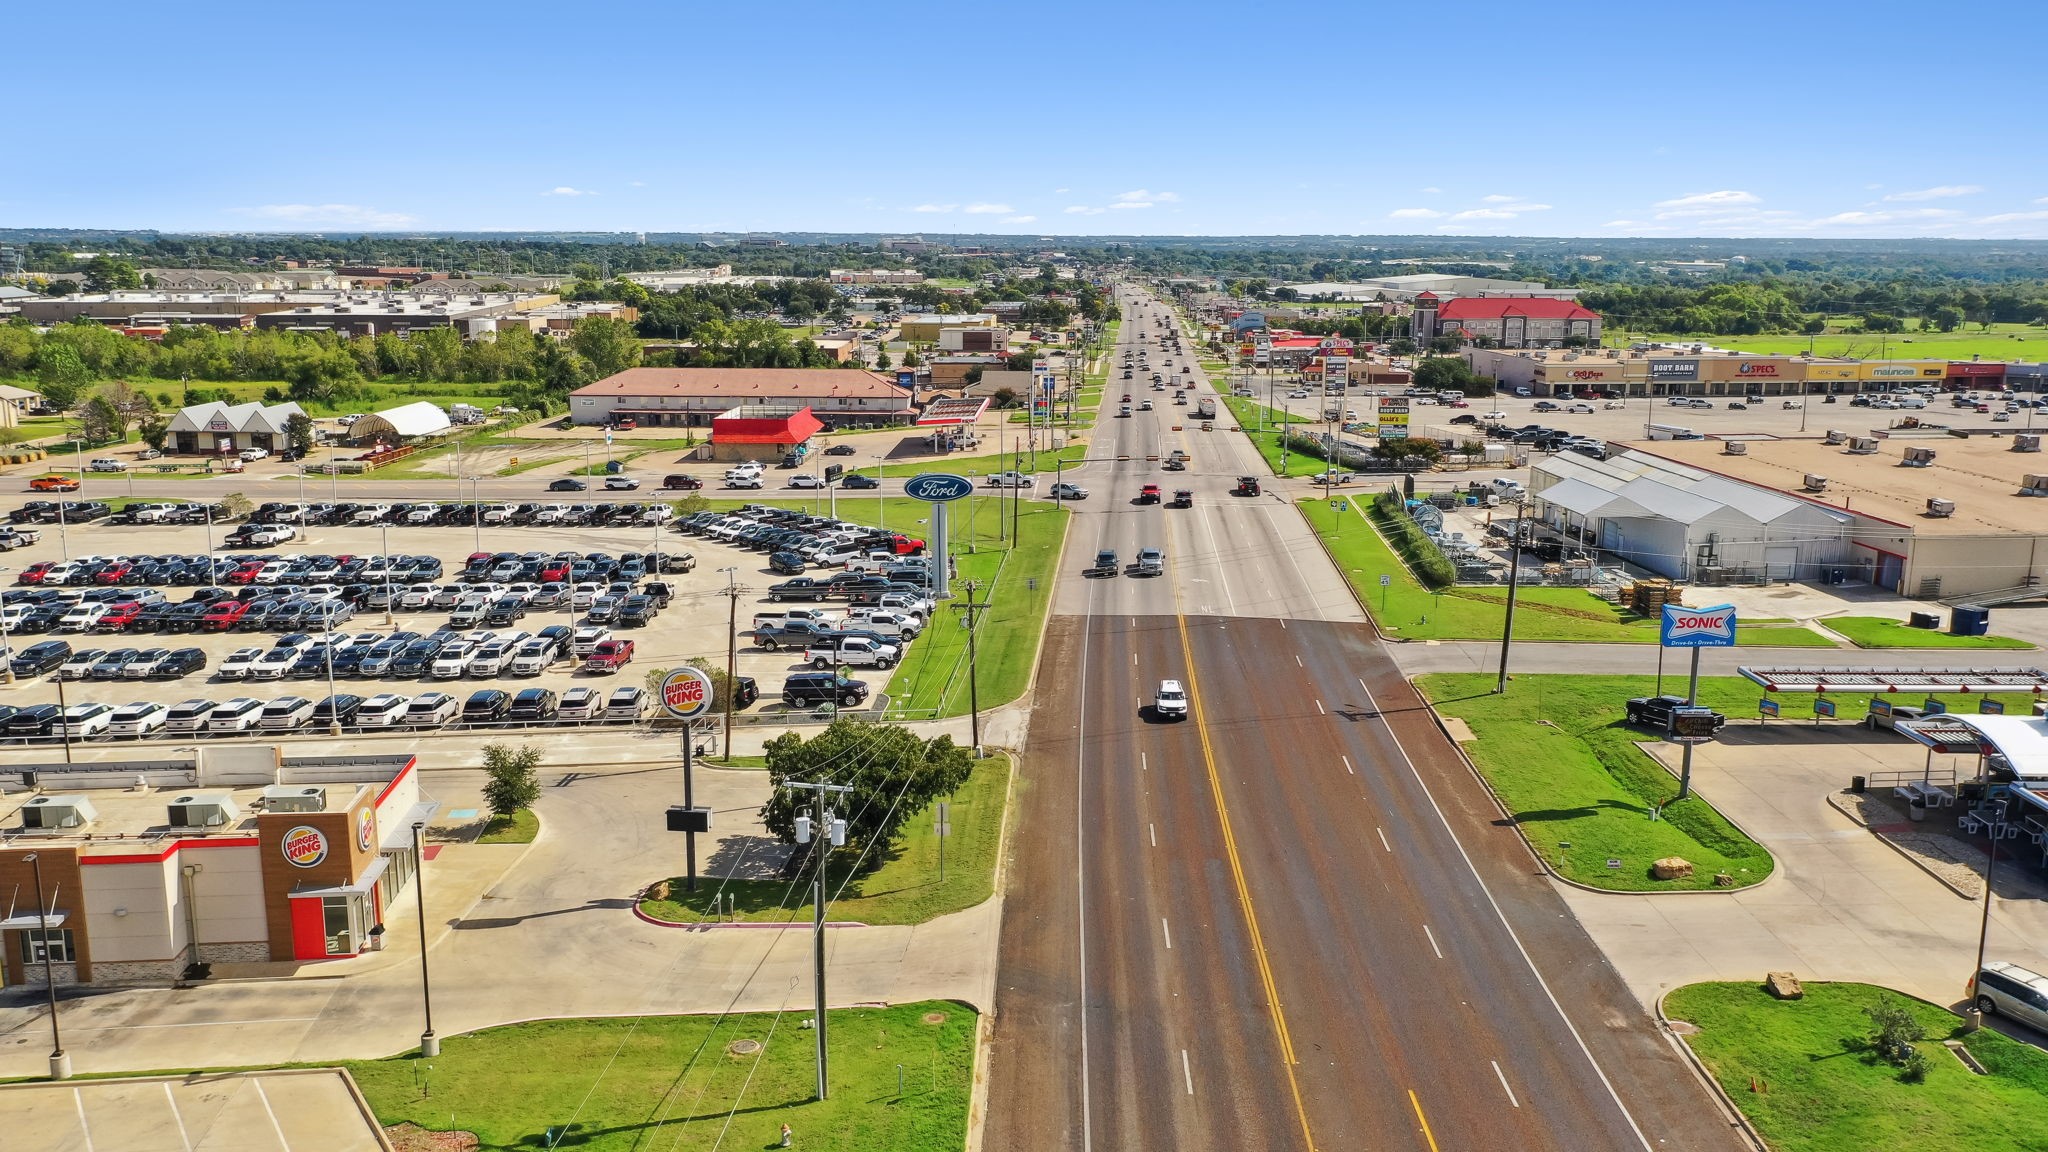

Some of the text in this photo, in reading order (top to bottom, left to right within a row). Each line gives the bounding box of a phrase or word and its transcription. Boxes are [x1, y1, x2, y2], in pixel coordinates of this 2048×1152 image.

[918, 480, 959, 497] Ford
[1675, 617, 1724, 629] SONIC
[665, 680, 702, 695] BURGER
[667, 689, 703, 706] KING
[287, 833, 319, 850] BURGER
[289, 841, 321, 859] KING
